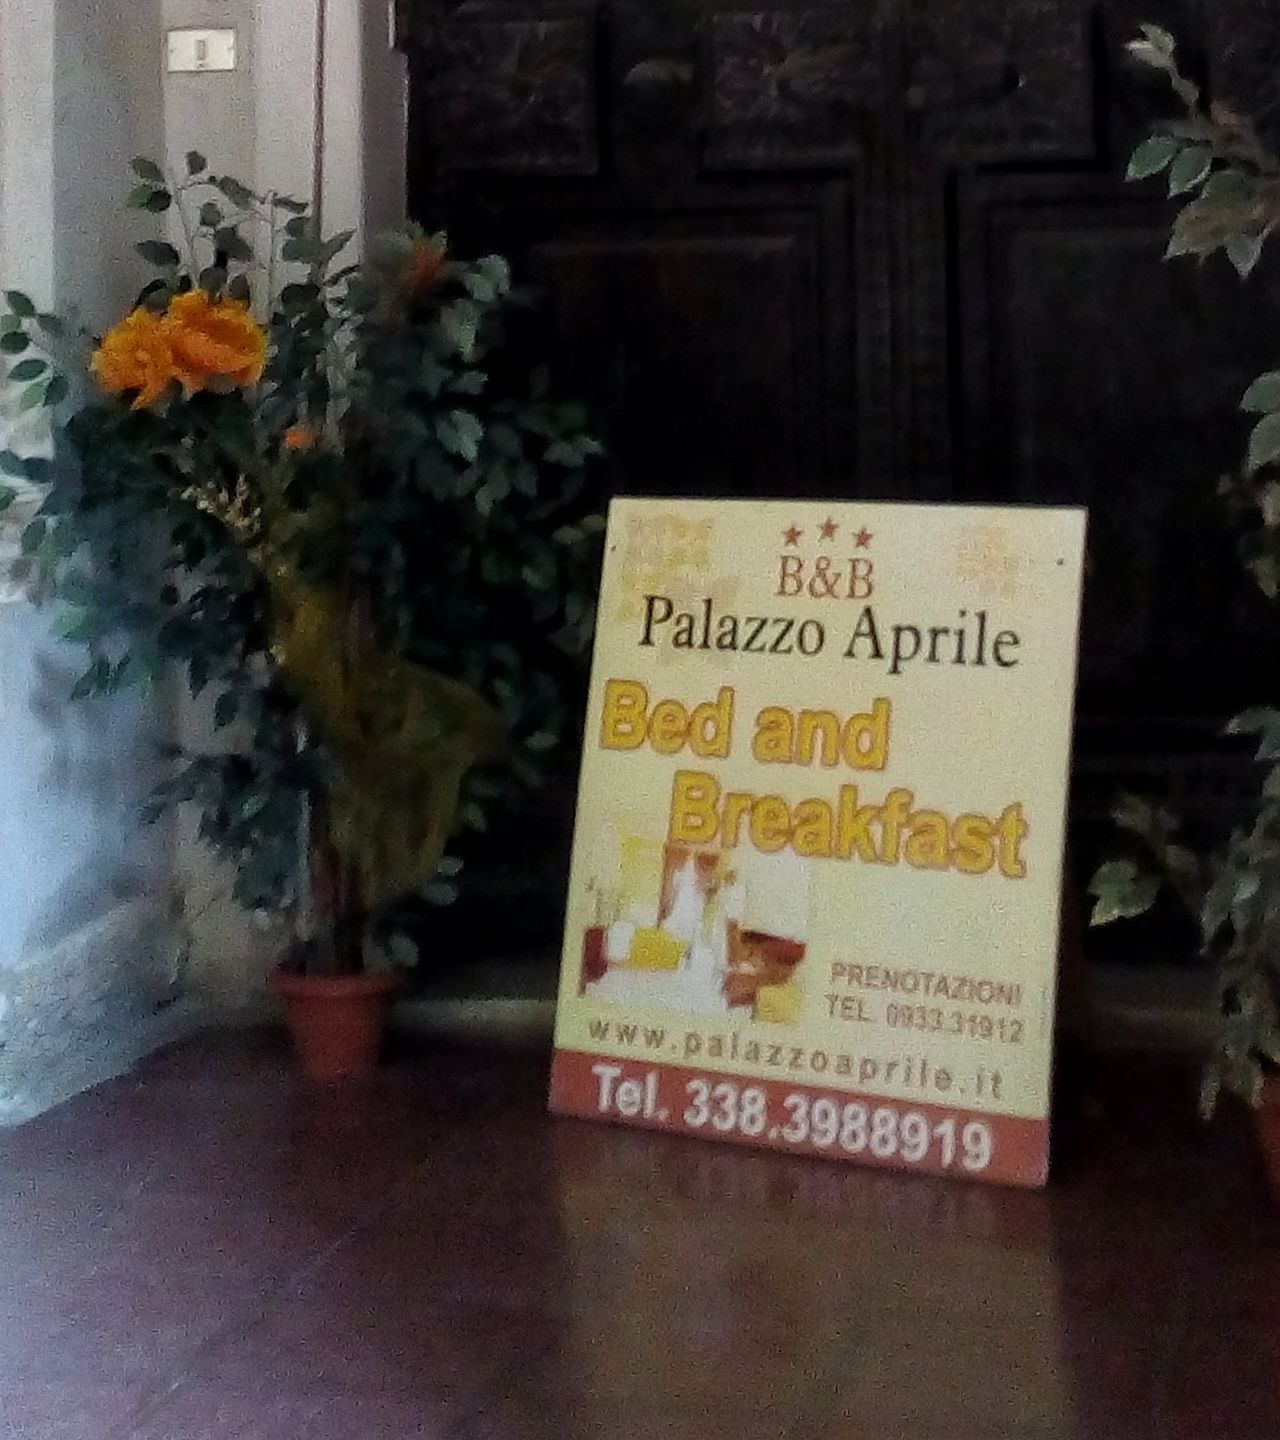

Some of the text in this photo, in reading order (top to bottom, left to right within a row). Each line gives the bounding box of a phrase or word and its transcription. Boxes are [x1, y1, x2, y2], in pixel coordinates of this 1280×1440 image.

[775, 555, 875, 600] B&B
[638, 595, 1021, 674] Palazzo Aprile
[599, 678, 893, 771] Bed and
[665, 770, 1028, 878] Breakfast
[830, 962, 1023, 1008] PRENOTAZIONI
[588, 1016, 1004, 1101] www.palazzoaprile.it
[591, 1063, 994, 1173] Tel. 338.3988919
